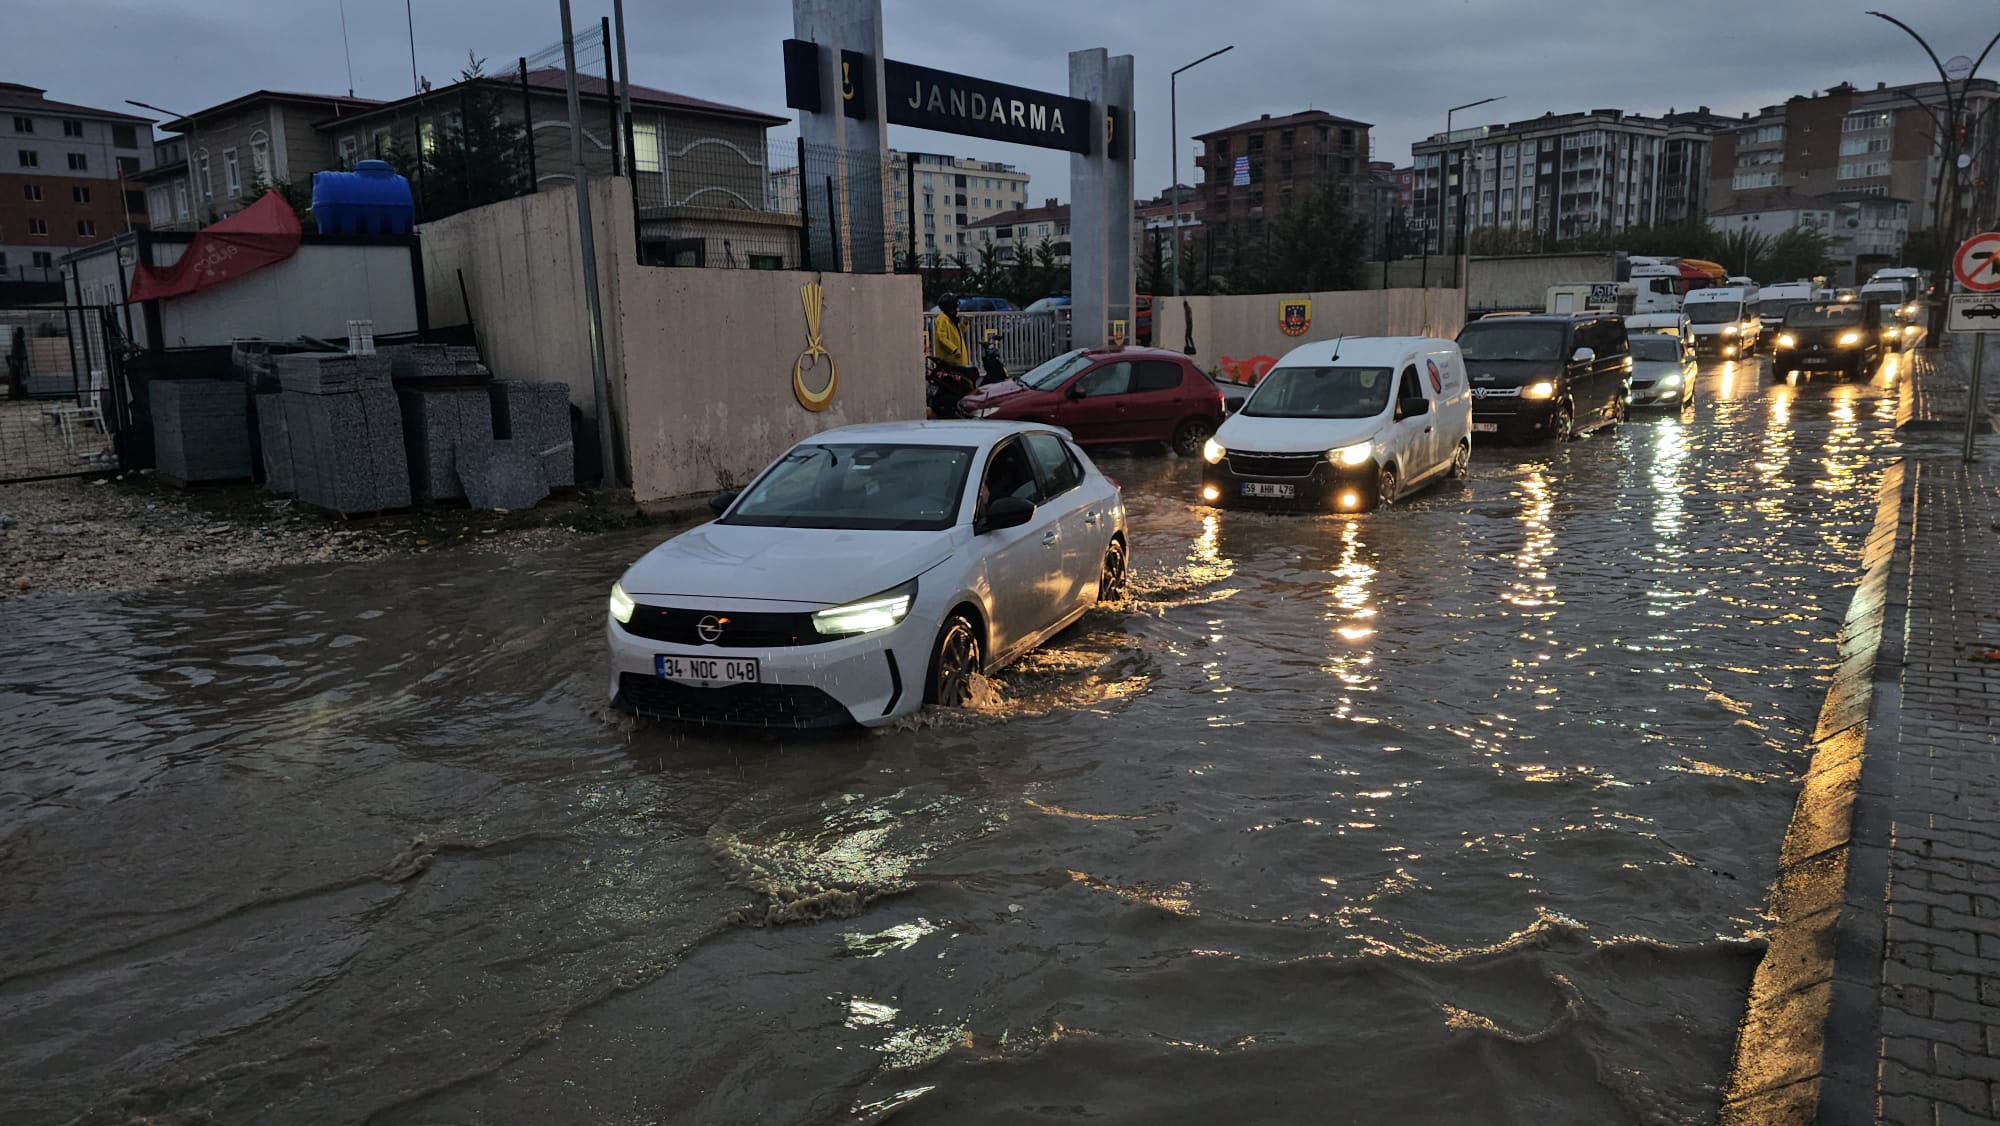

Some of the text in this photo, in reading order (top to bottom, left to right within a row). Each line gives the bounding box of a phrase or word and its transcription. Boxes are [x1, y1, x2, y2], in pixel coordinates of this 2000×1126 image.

[908, 80, 1065, 134] JANDARMA
[665, 659, 755, 681] 34 NOC 048
